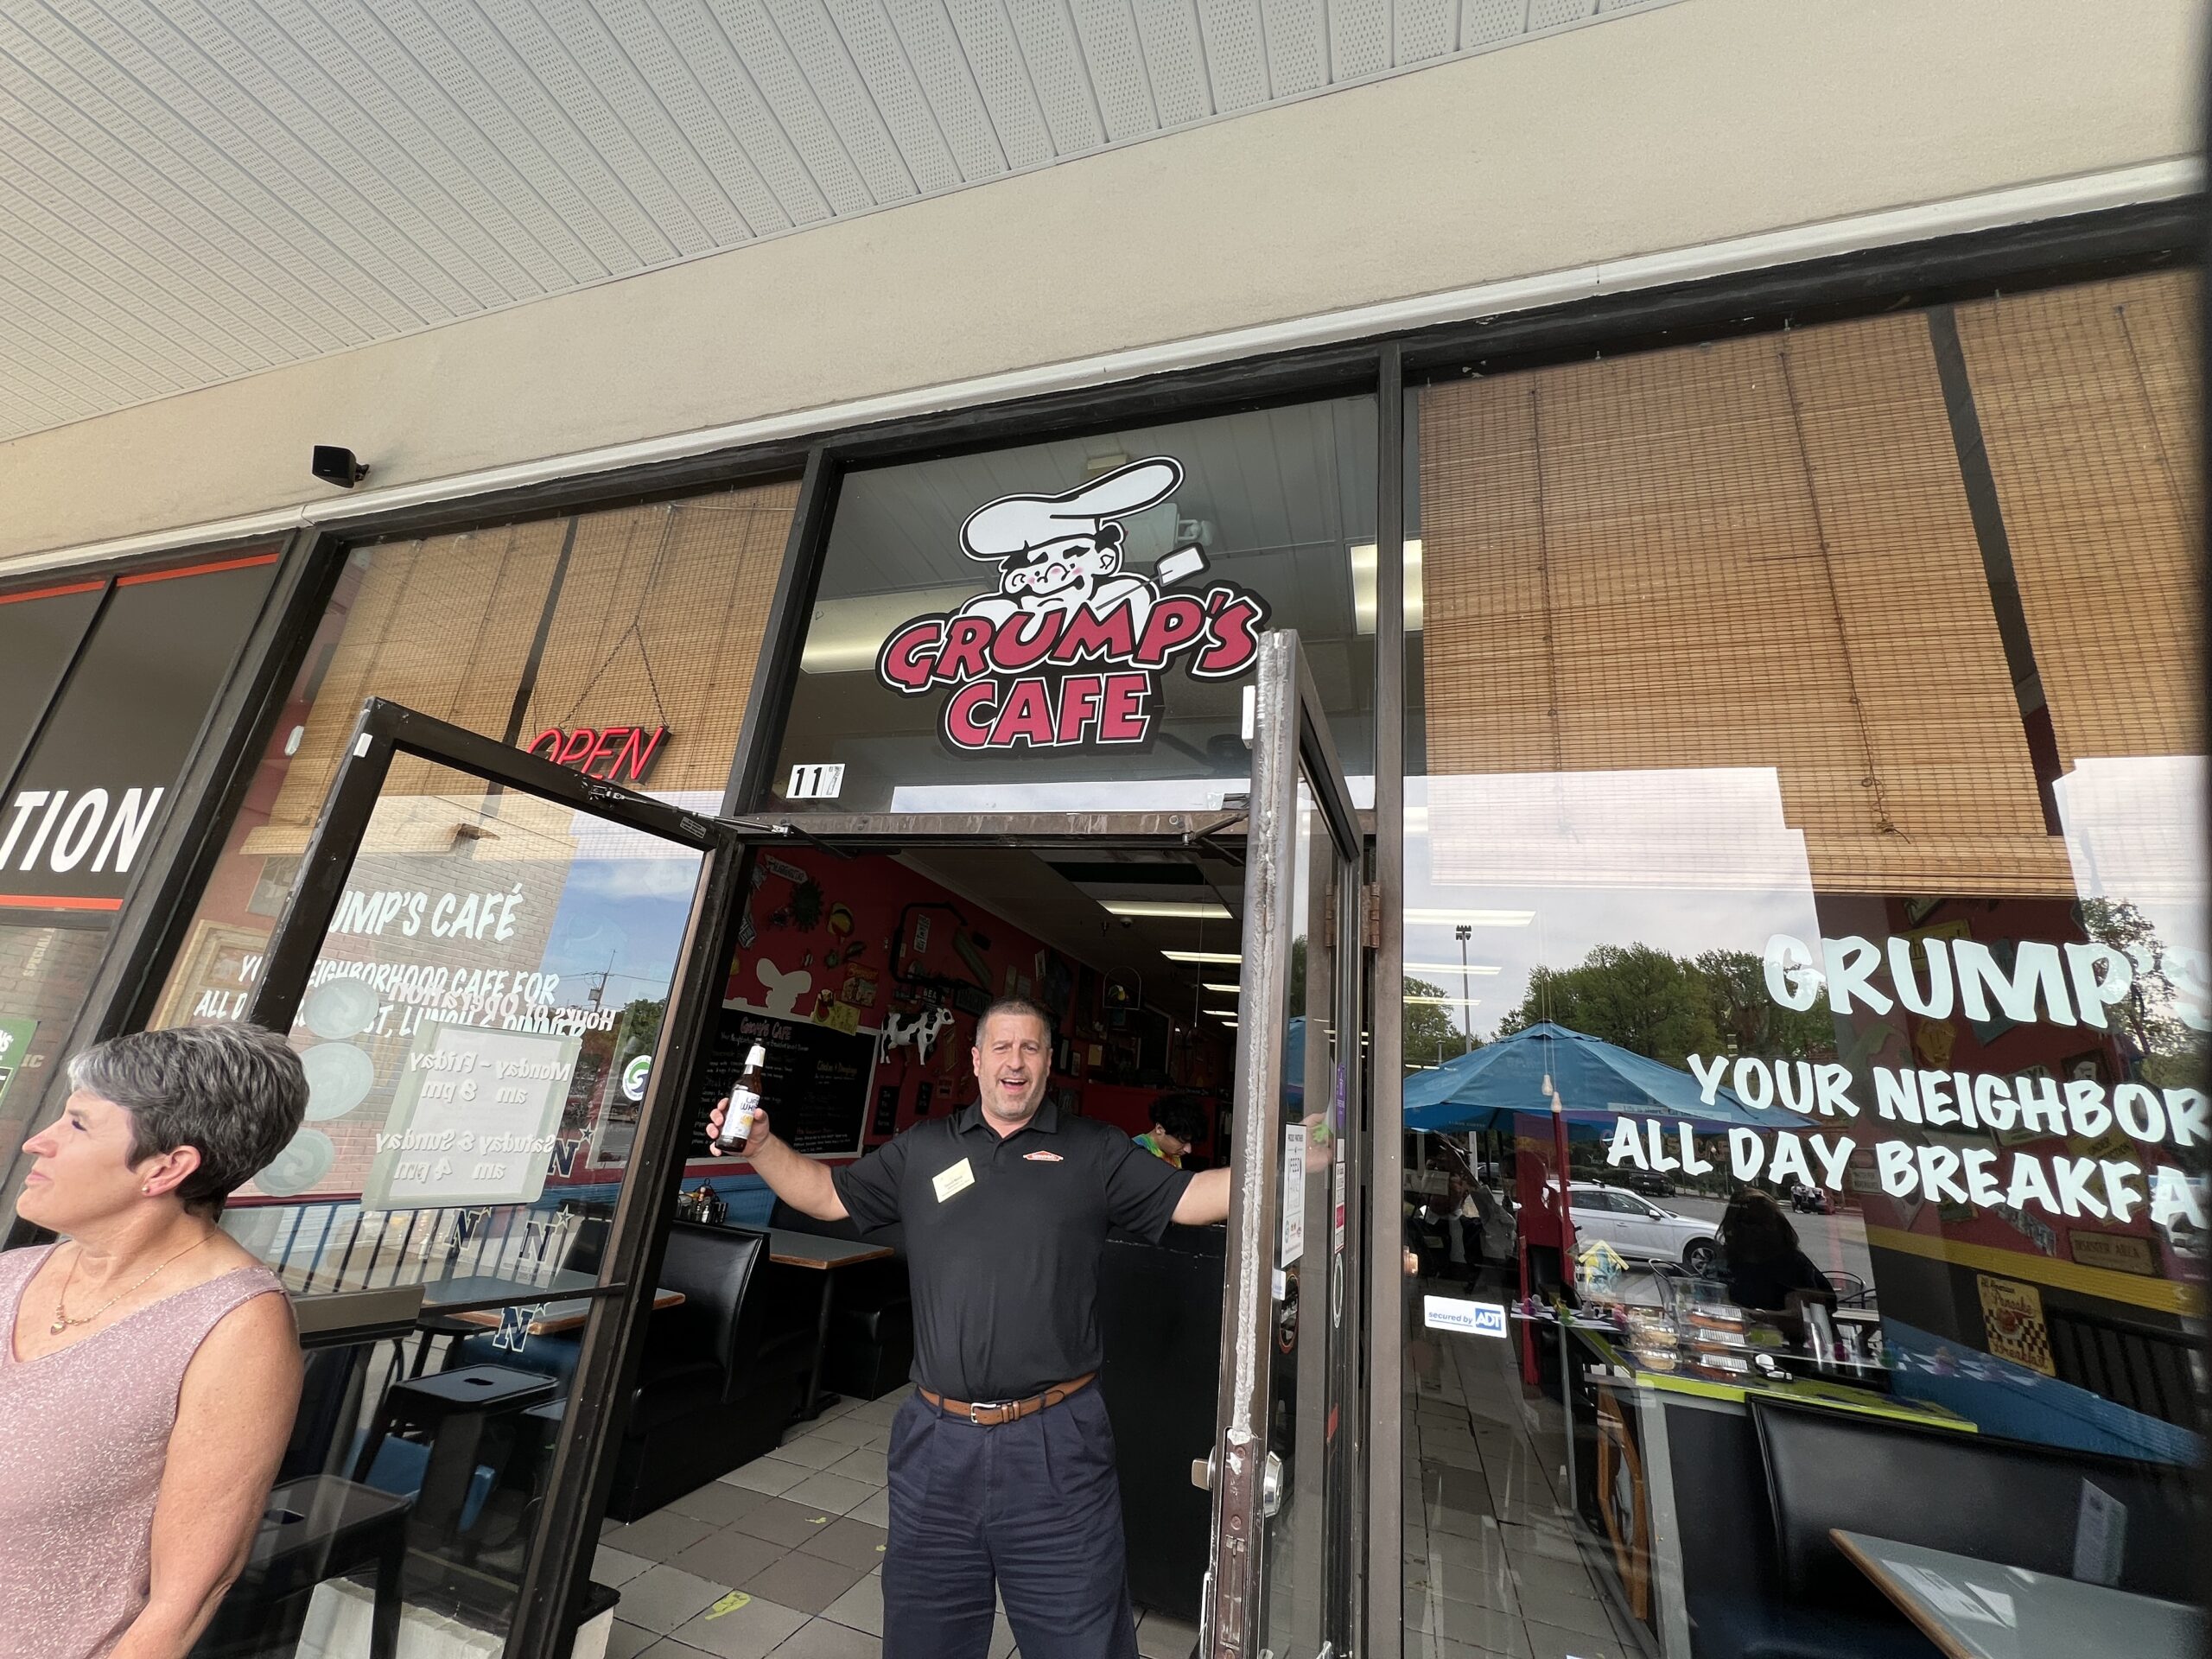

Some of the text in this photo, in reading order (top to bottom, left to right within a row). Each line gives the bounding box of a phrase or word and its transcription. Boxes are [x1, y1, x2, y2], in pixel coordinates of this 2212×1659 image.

[883, 589, 1262, 692] GRUMP'S
[945, 671, 1151, 748] CAFE
[526, 725, 664, 780] OPEN
[0, 786, 164, 874] TION
[330, 882, 524, 942] UMP'S CAFÉ
[194, 990, 230, 1019] ALL
[308, 958, 448, 997] EIGHBORHOOD
[512, 971, 560, 1005] FOR
[1687, 1053, 2211, 1147] YOUR NEIGHBOR
[1606, 1116, 1713, 1176] ALL
[1728, 1127, 1856, 1192] DAY
[1875, 1135, 2209, 1229] BREAKFA
[1428, 1312, 1501, 1329] secured by ADT
